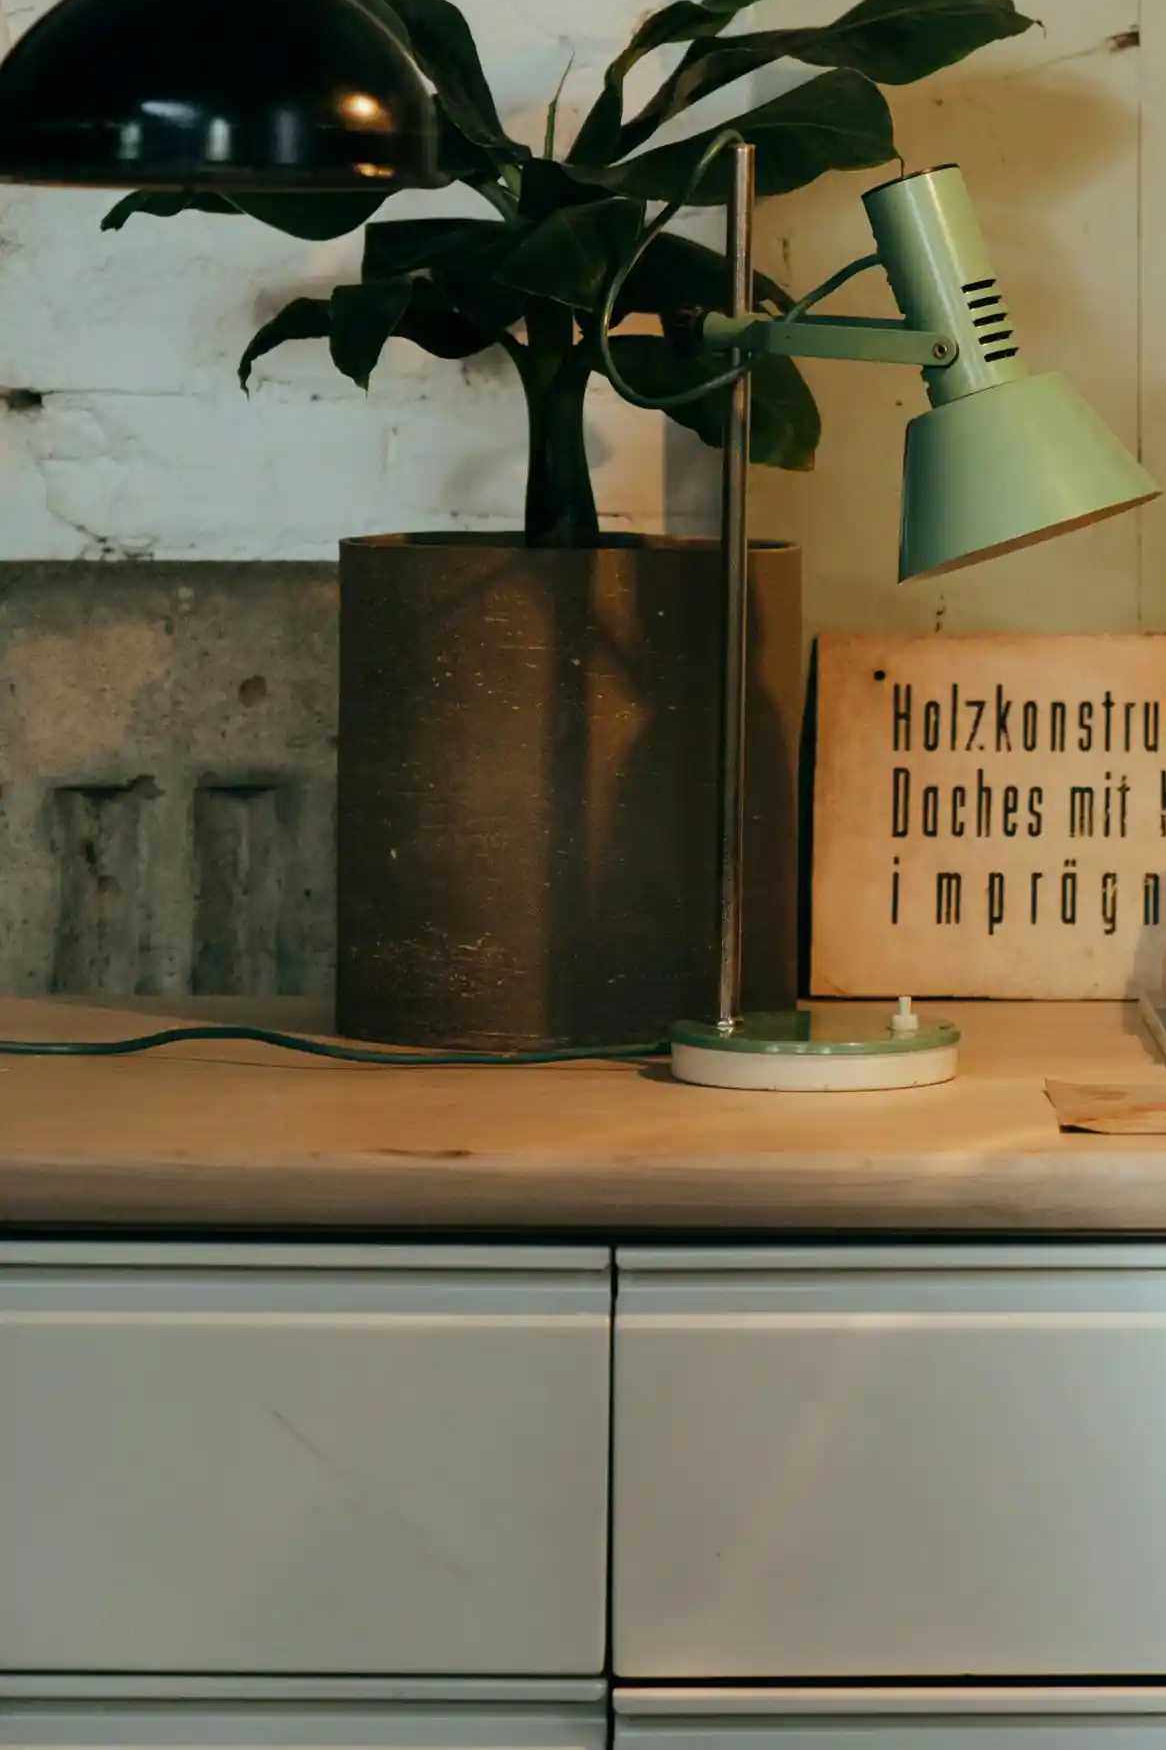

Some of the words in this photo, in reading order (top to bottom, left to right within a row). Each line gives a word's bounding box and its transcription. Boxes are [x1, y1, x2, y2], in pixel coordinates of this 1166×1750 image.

[891, 767, 1043, 838] Daches
[1067, 770, 1131, 838] mit
[890, 855, 1161, 936] imprägn
